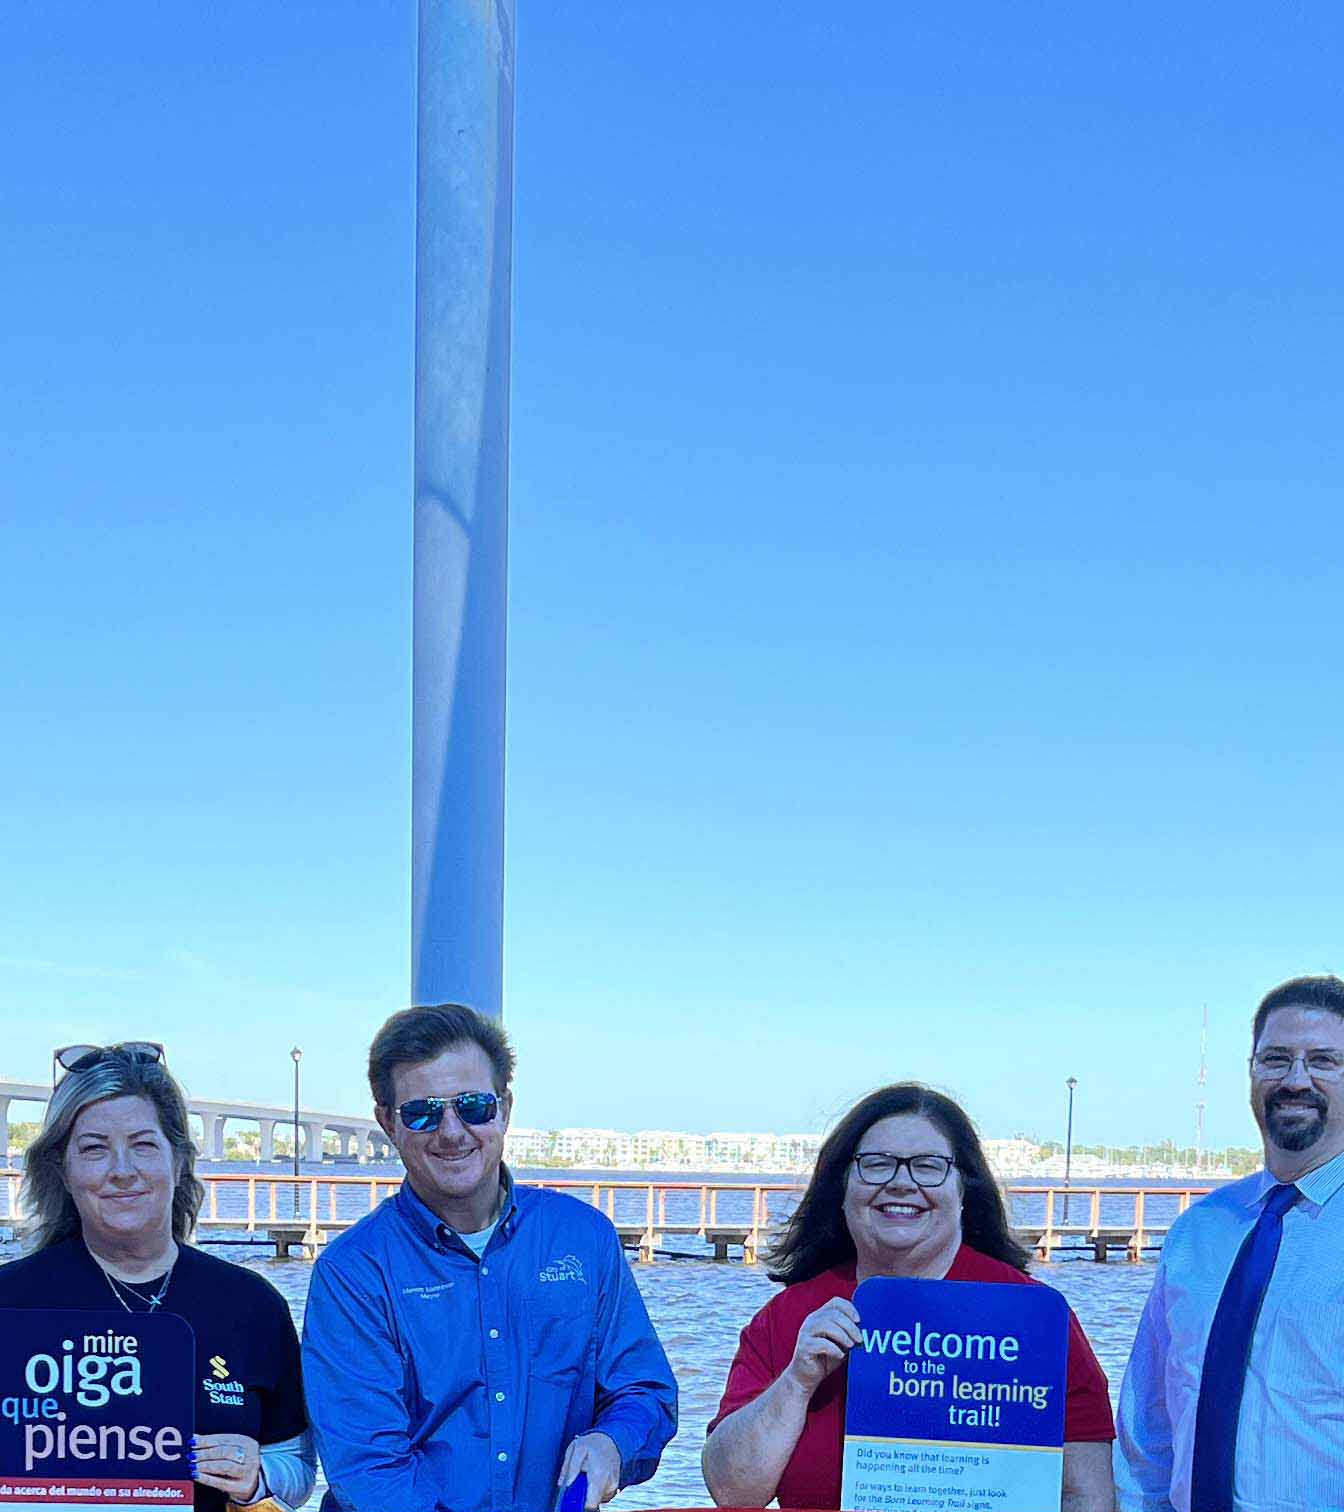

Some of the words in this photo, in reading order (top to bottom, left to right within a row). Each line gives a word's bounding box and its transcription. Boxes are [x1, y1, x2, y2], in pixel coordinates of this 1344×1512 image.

[539, 1271, 576, 1282] Stuart
[83, 1329, 138, 1354] mire
[861, 1322, 1019, 1361] welcome
[25, 1339, 143, 1407] oiga
[904, 1359, 919, 1374] to
[921, 1360, 945, 1375] the
[203, 1379, 244, 1393] South
[889, 1371, 945, 1399] born
[952, 1374, 1049, 1410] learning
[209, 1391, 244, 1406] State
[948, 1404, 1001, 1428] trail!
[25, 1412, 183, 1471] piense
[857, 1448, 873, 1458] Did
[873, 1451, 892, 1460] you
[893, 1450, 919, 1460] know
[920, 1452, 939, 1462] that
[941, 1453, 979, 1467] learning
[981, 1455, 990, 1465] is
[856, 1461, 906, 1474] happening
[907, 1463, 920, 1473] all
[921, 1464, 937, 1474] the
[938, 1465, 965, 1476] time?
[14, 1486, 47, 1496] acerca
[49, 1485, 65, 1496] del
[66, 1485, 102, 1497] mundo
[103, 1488, 117, 1497] en
[118, 1488, 131, 1497] su
[133, 1486, 185, 1498] alrededor.
[855, 1480, 871, 1490] For
[871, 1482, 892, 1493] ways
[894, 1483, 903, 1491] to
[904, 1483, 927, 1493] learn
[969, 1486, 986, 1498] just
[987, 1488, 1007, 1498] look
[855, 1493, 867, 1502] for
[868, 1494, 883, 1504] the
[884, 1495, 906, 1504] Born
[907, 1495, 945, 1509] Learning
[947, 1497, 965, 1508] Trail
